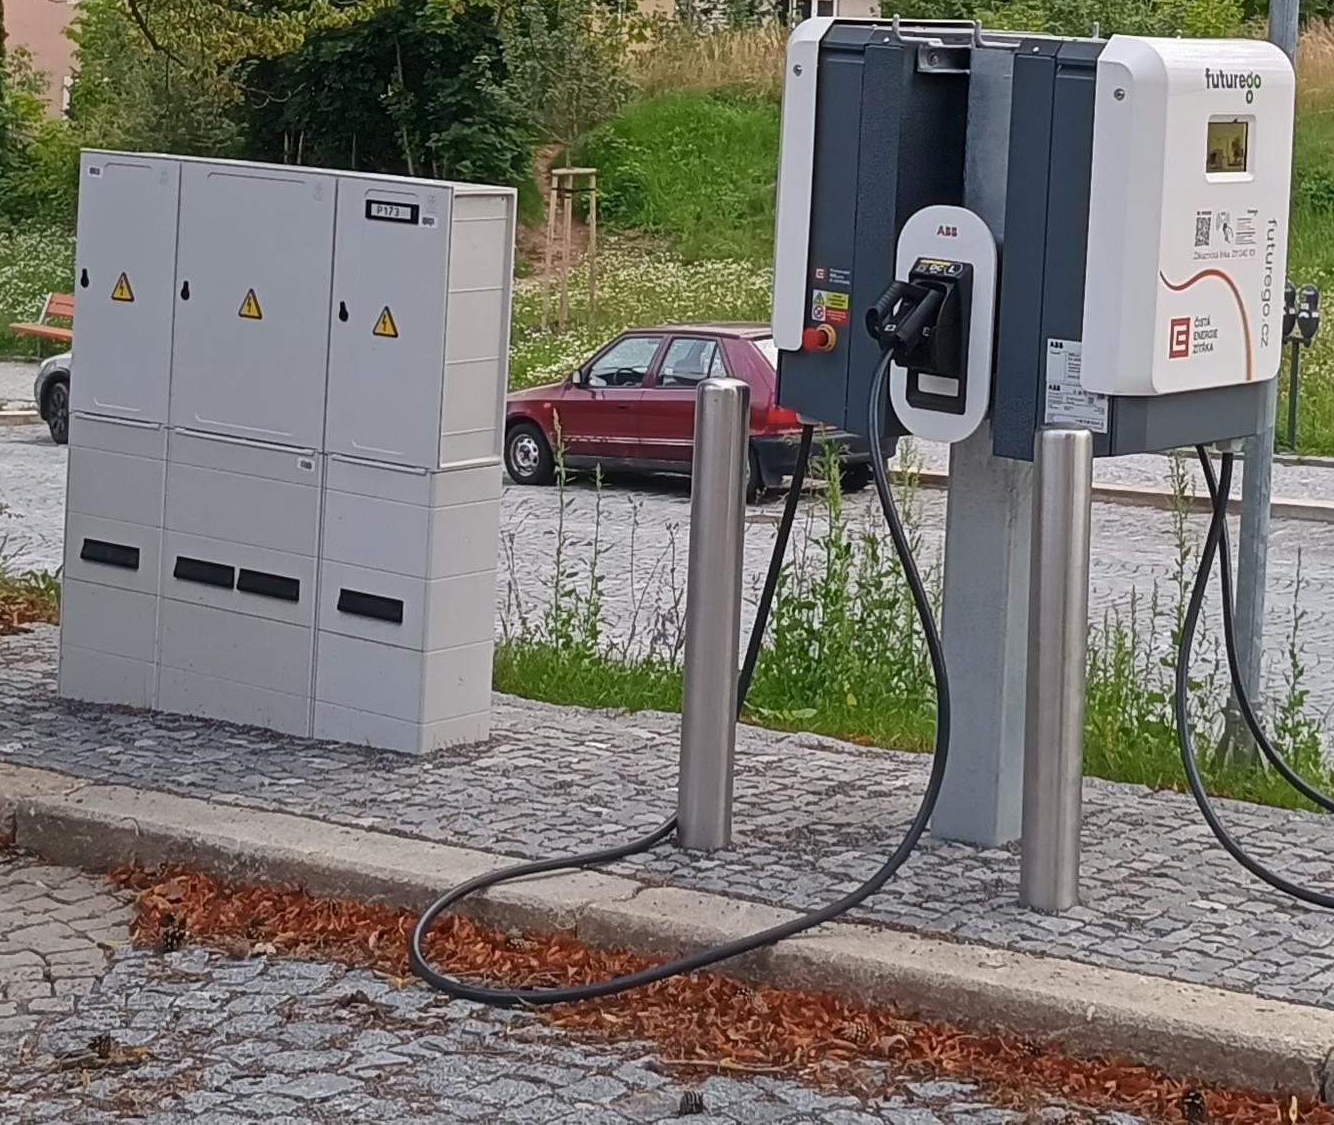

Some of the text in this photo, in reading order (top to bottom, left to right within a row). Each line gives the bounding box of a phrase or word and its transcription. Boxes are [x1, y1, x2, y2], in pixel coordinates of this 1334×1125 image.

[1205, 67, 1262, 104] futurego
[376, 205, 400, 217] P173
[937, 225, 958, 237] ABB
[1260, 217, 1277, 348] futurego.cz
